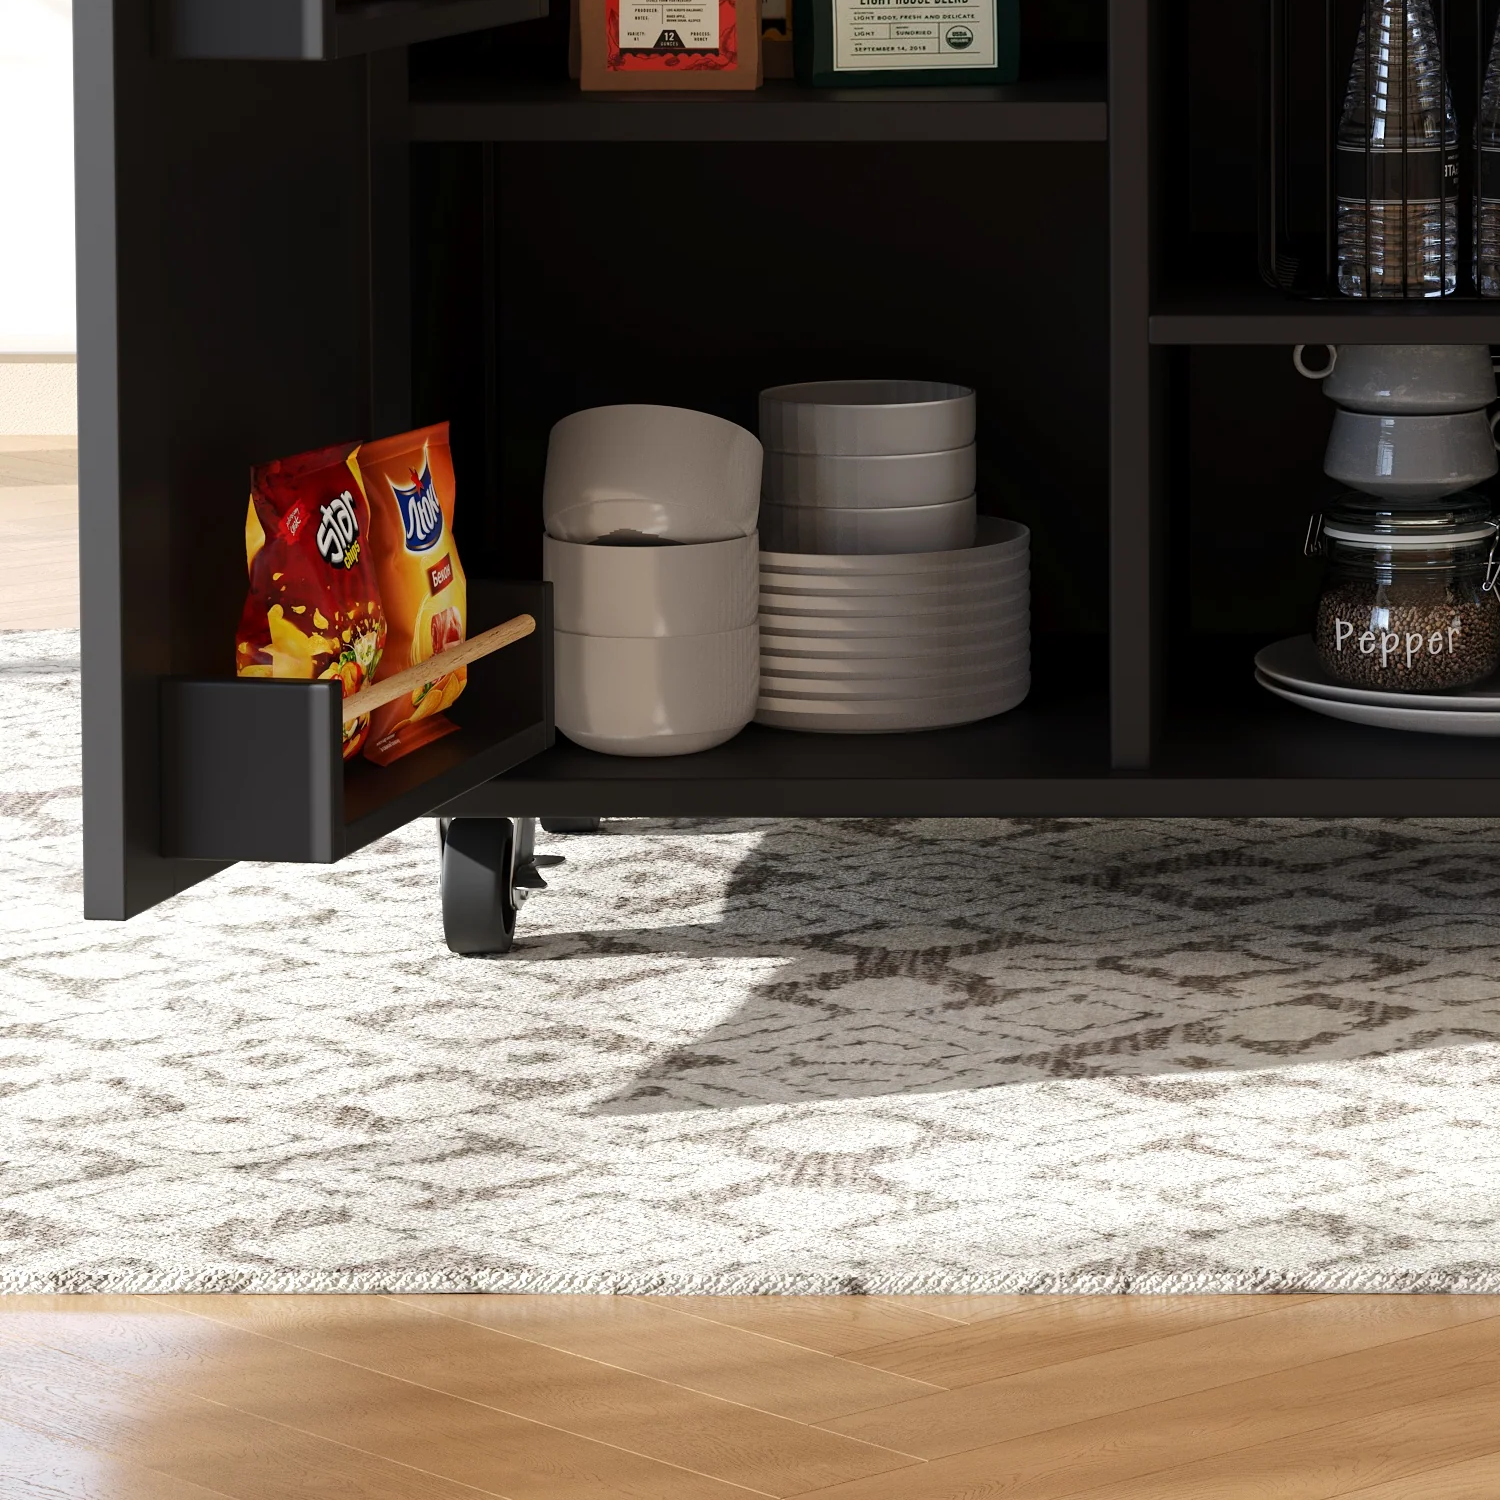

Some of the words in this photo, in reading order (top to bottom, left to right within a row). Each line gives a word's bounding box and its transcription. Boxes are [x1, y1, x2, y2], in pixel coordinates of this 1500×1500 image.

[664, 32, 675, 41] 12
[343, 540, 360, 570] chips
[431, 563, 452, 588] Бекон
[1334, 617, 1461, 669] Pepper
